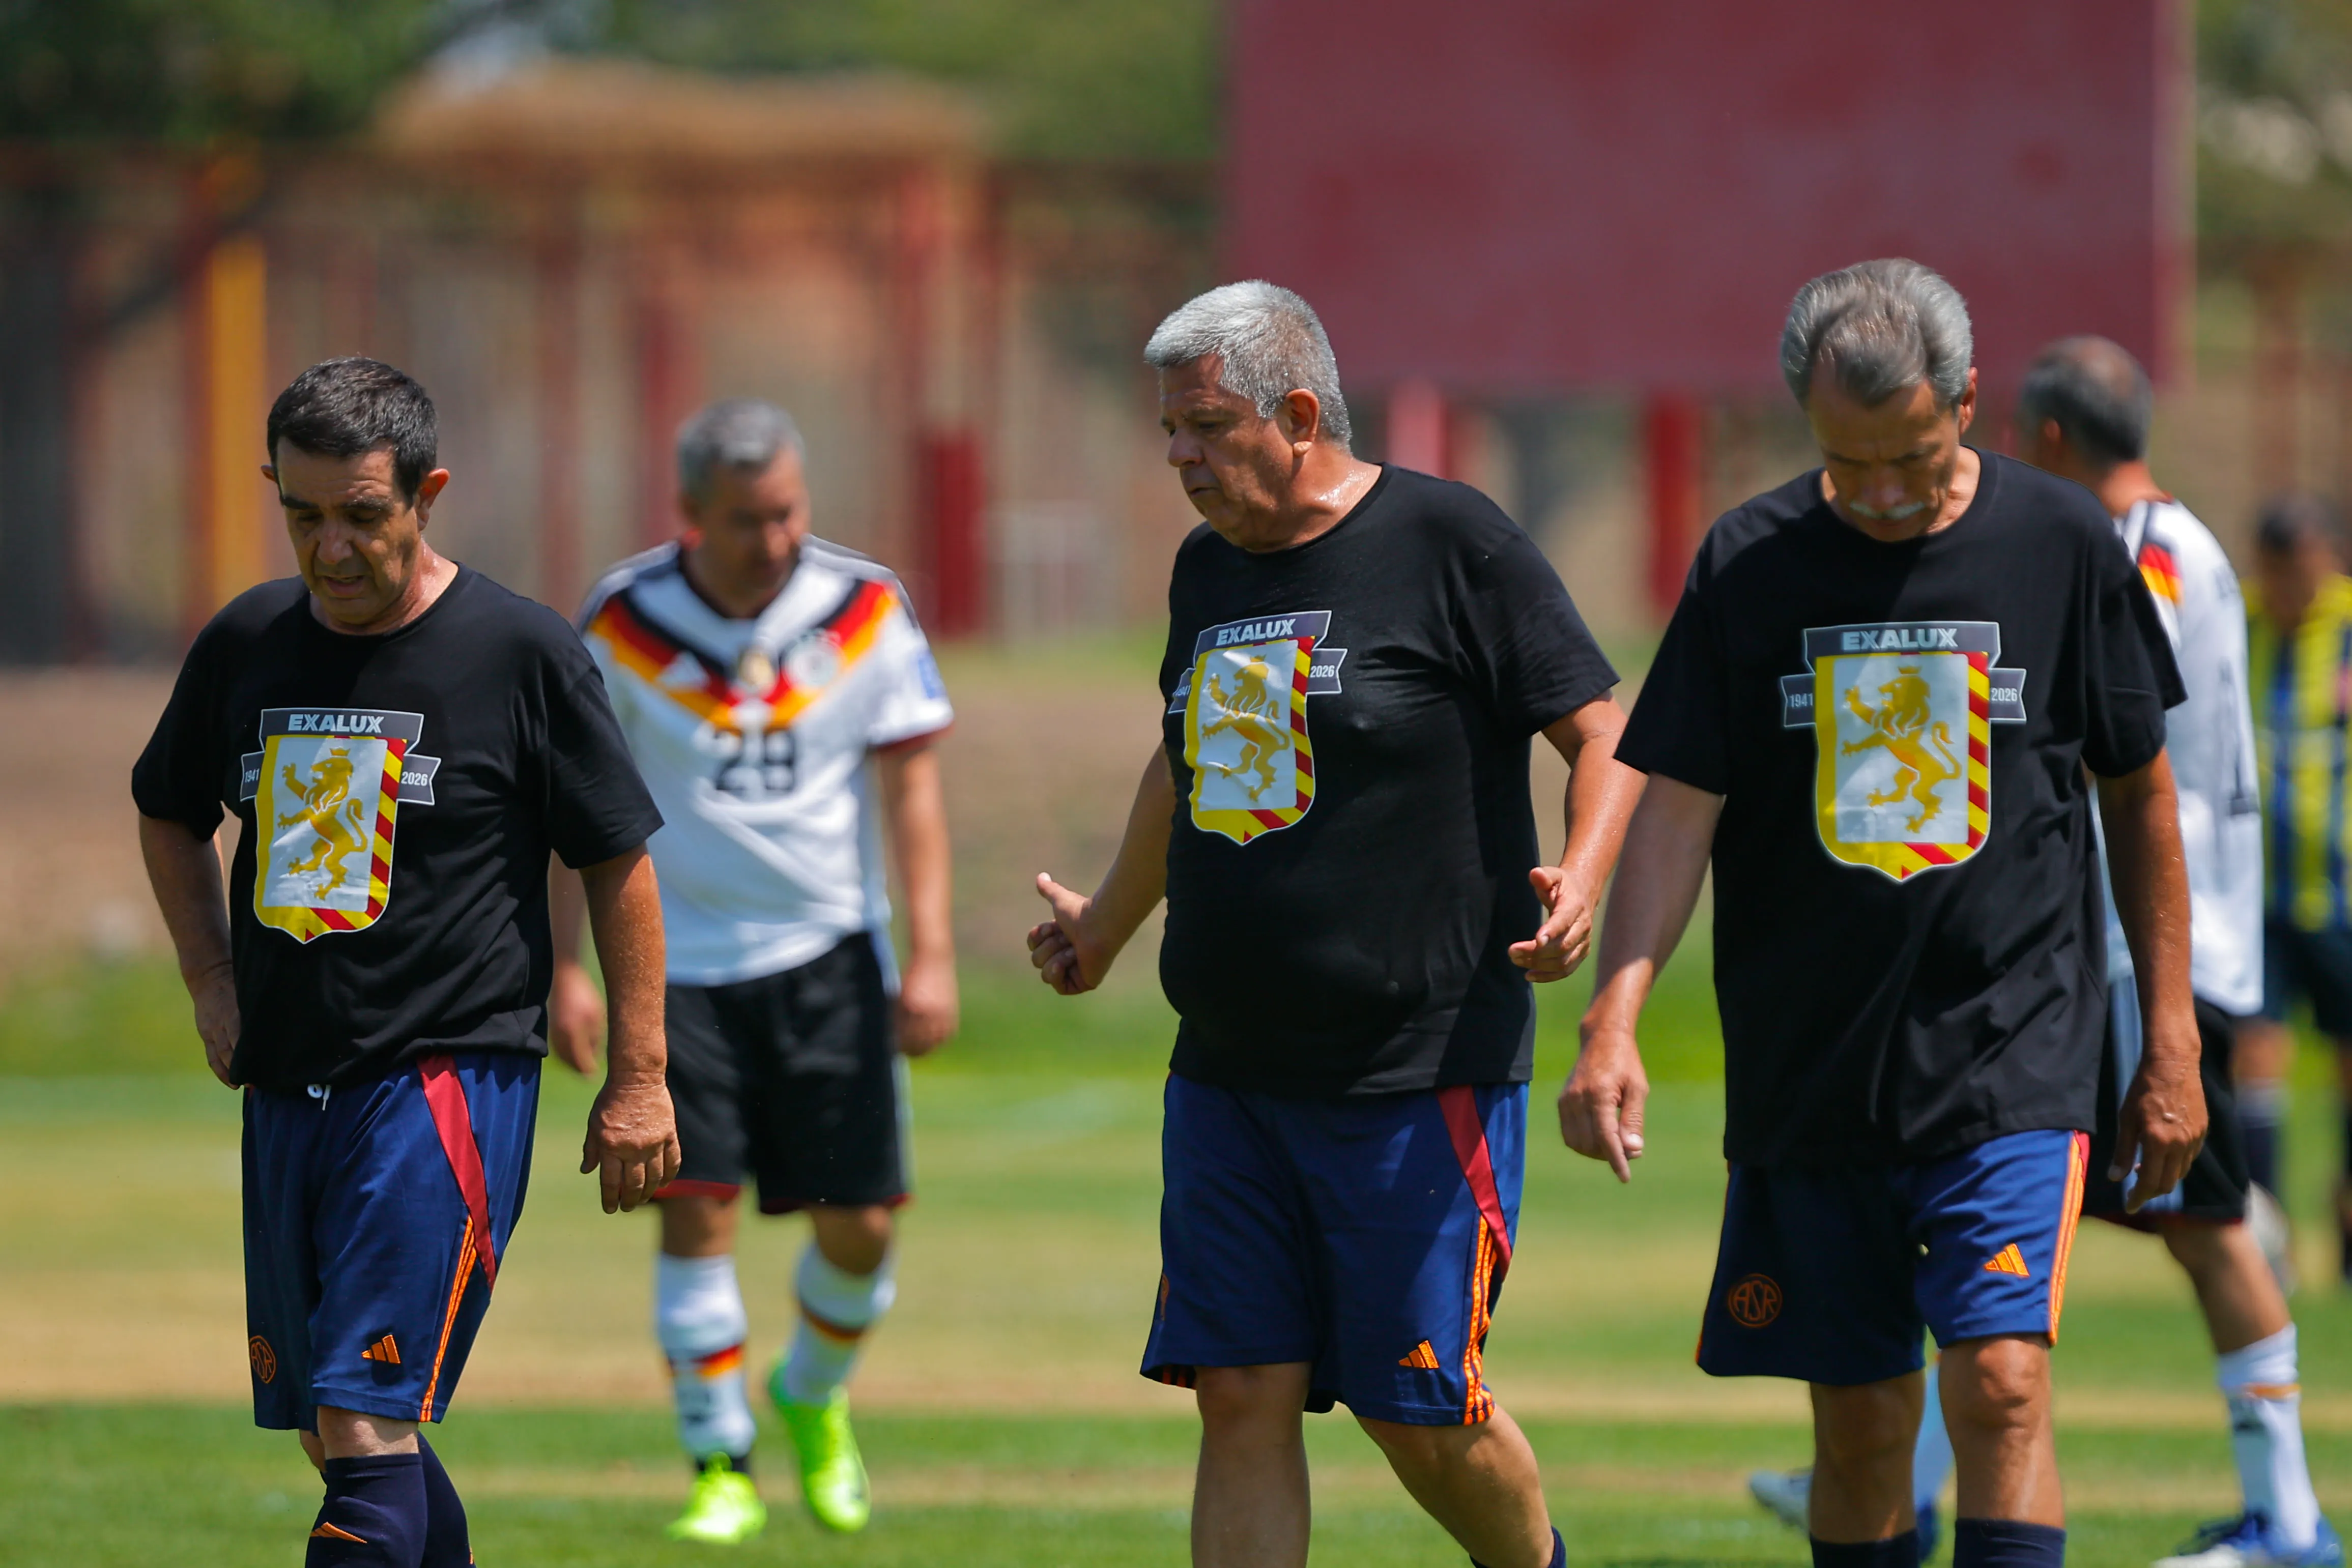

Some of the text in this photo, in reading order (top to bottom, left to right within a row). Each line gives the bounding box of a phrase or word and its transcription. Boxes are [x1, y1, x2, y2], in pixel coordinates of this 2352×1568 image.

[1215, 618, 1296, 646] EXALUX
[1842, 628, 1958, 650] EXALUX
[1310, 665, 1335, 678] 2026
[1789, 692, 1813, 708] 1941
[1991, 687, 2018, 702] 2026
[288, 713, 385, 734] EXALUX
[401, 771, 428, 787] 2026
